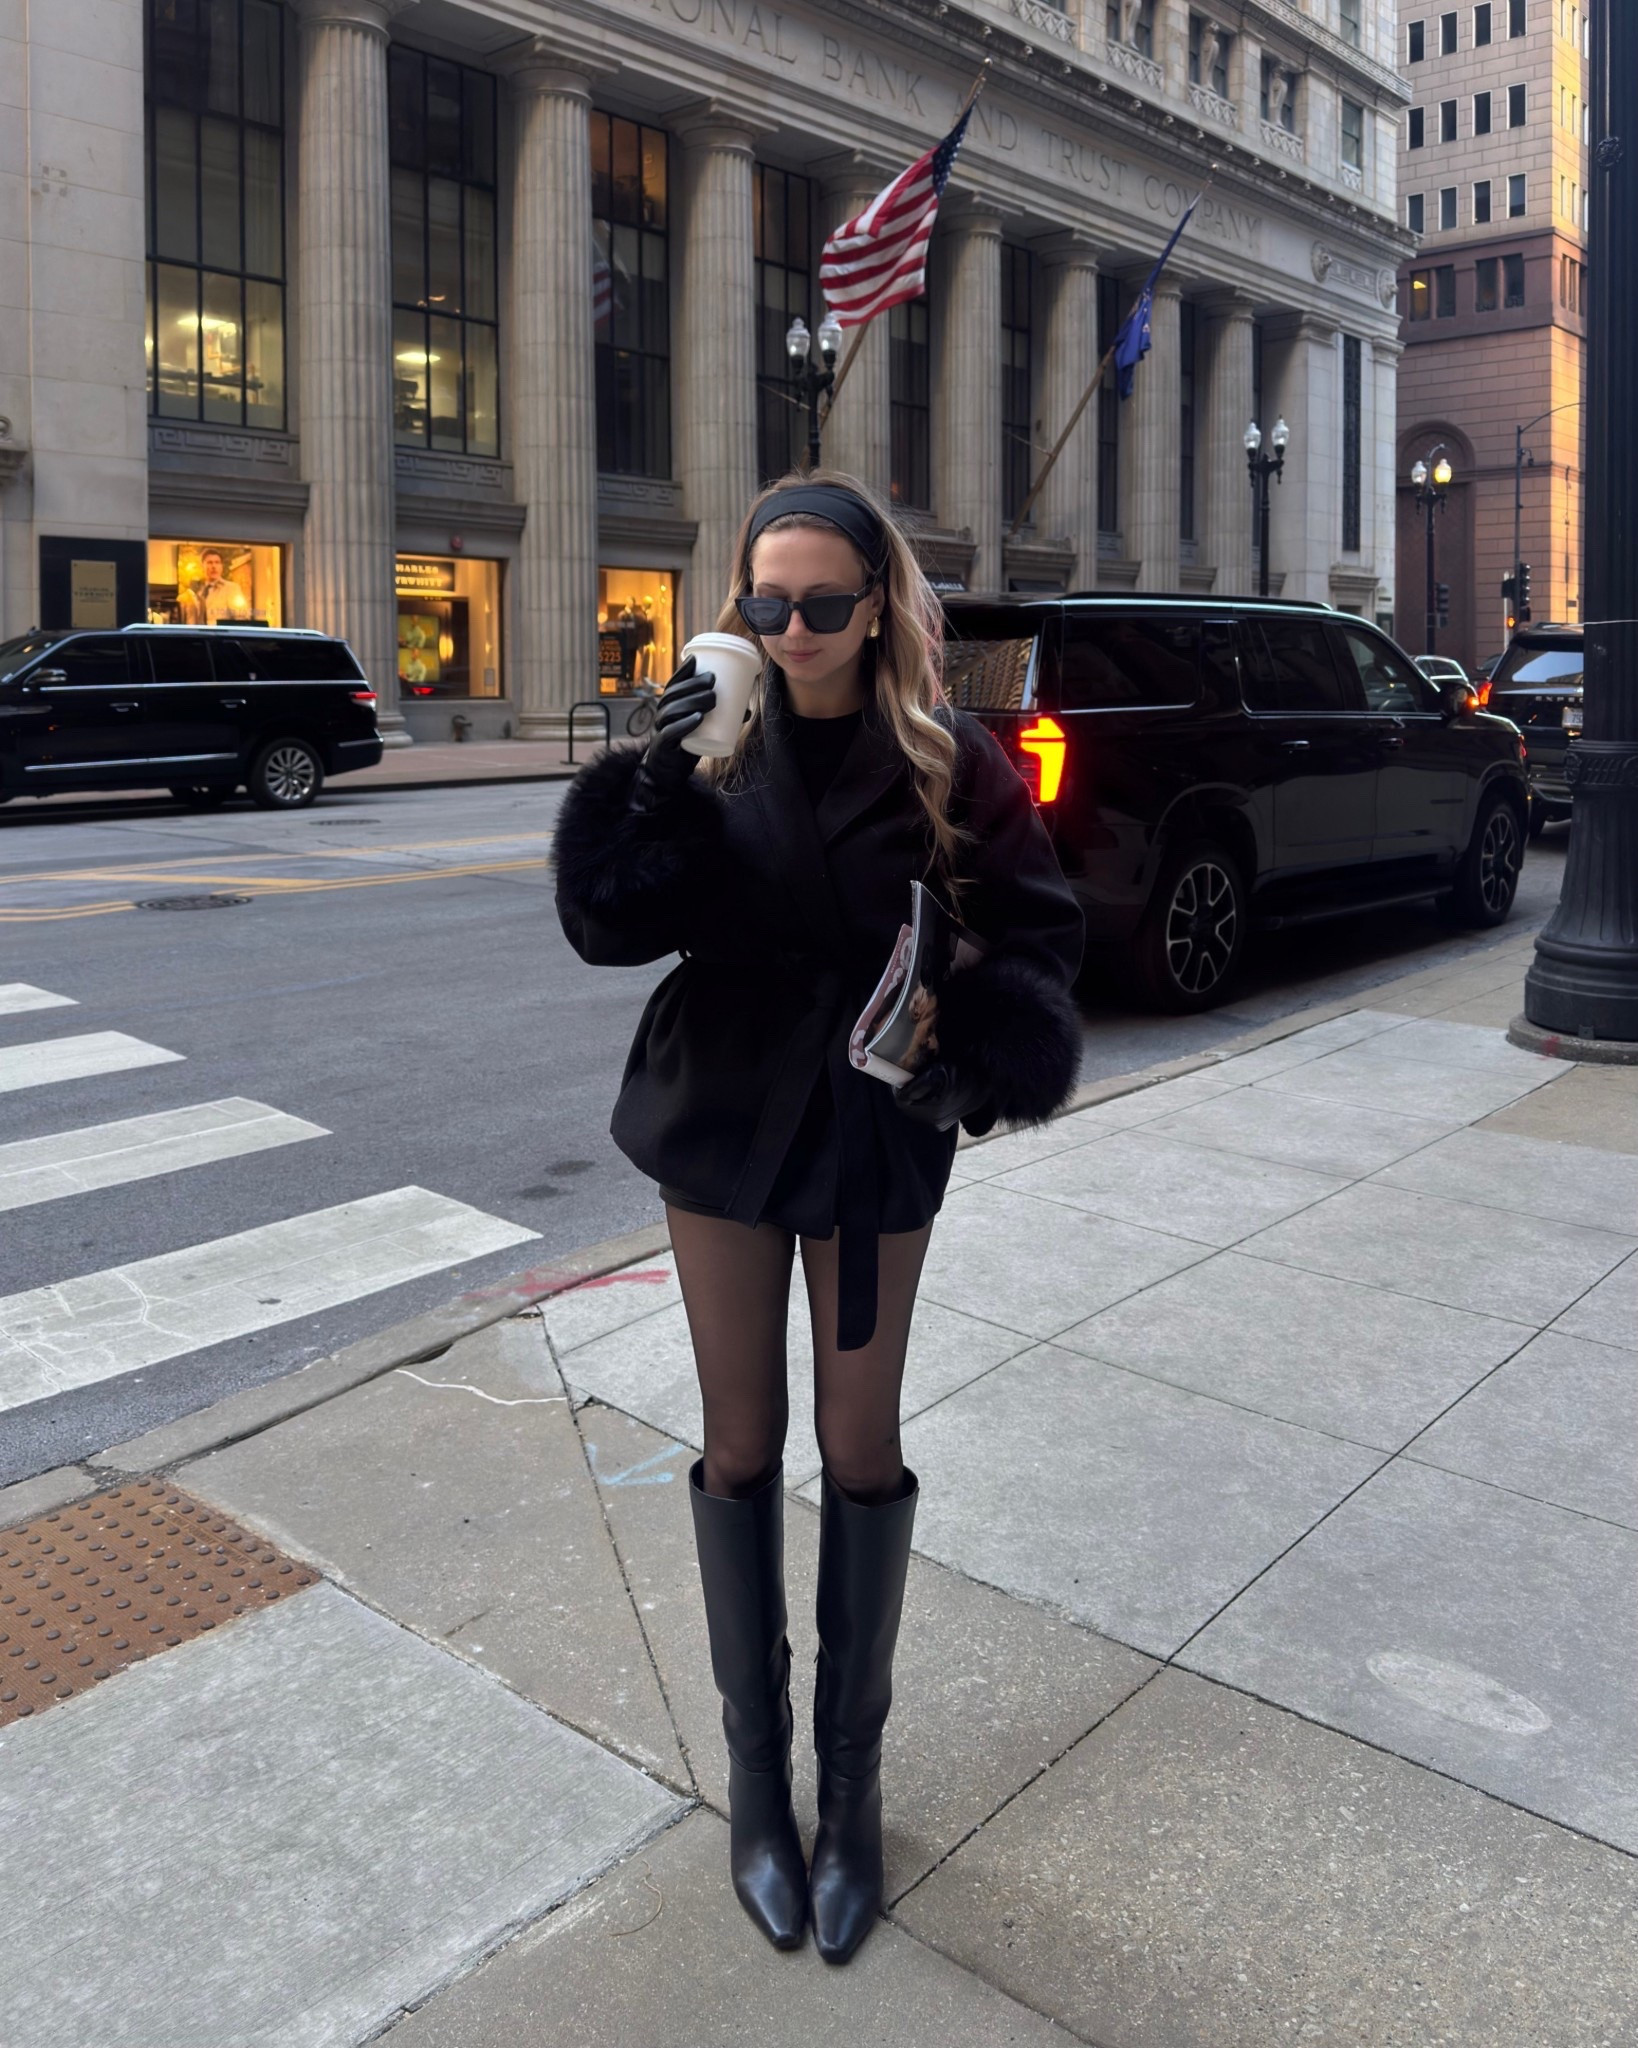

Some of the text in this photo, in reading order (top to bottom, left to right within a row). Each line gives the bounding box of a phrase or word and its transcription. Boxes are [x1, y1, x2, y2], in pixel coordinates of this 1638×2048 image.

[820, 33, 926, 117] BANK
[1041, 128, 1130, 196] TRUST
[1144, 175, 1263, 249] COMPANY
[395, 563, 439, 574] HARLES
[395, 576, 442, 587] YRWHITT
